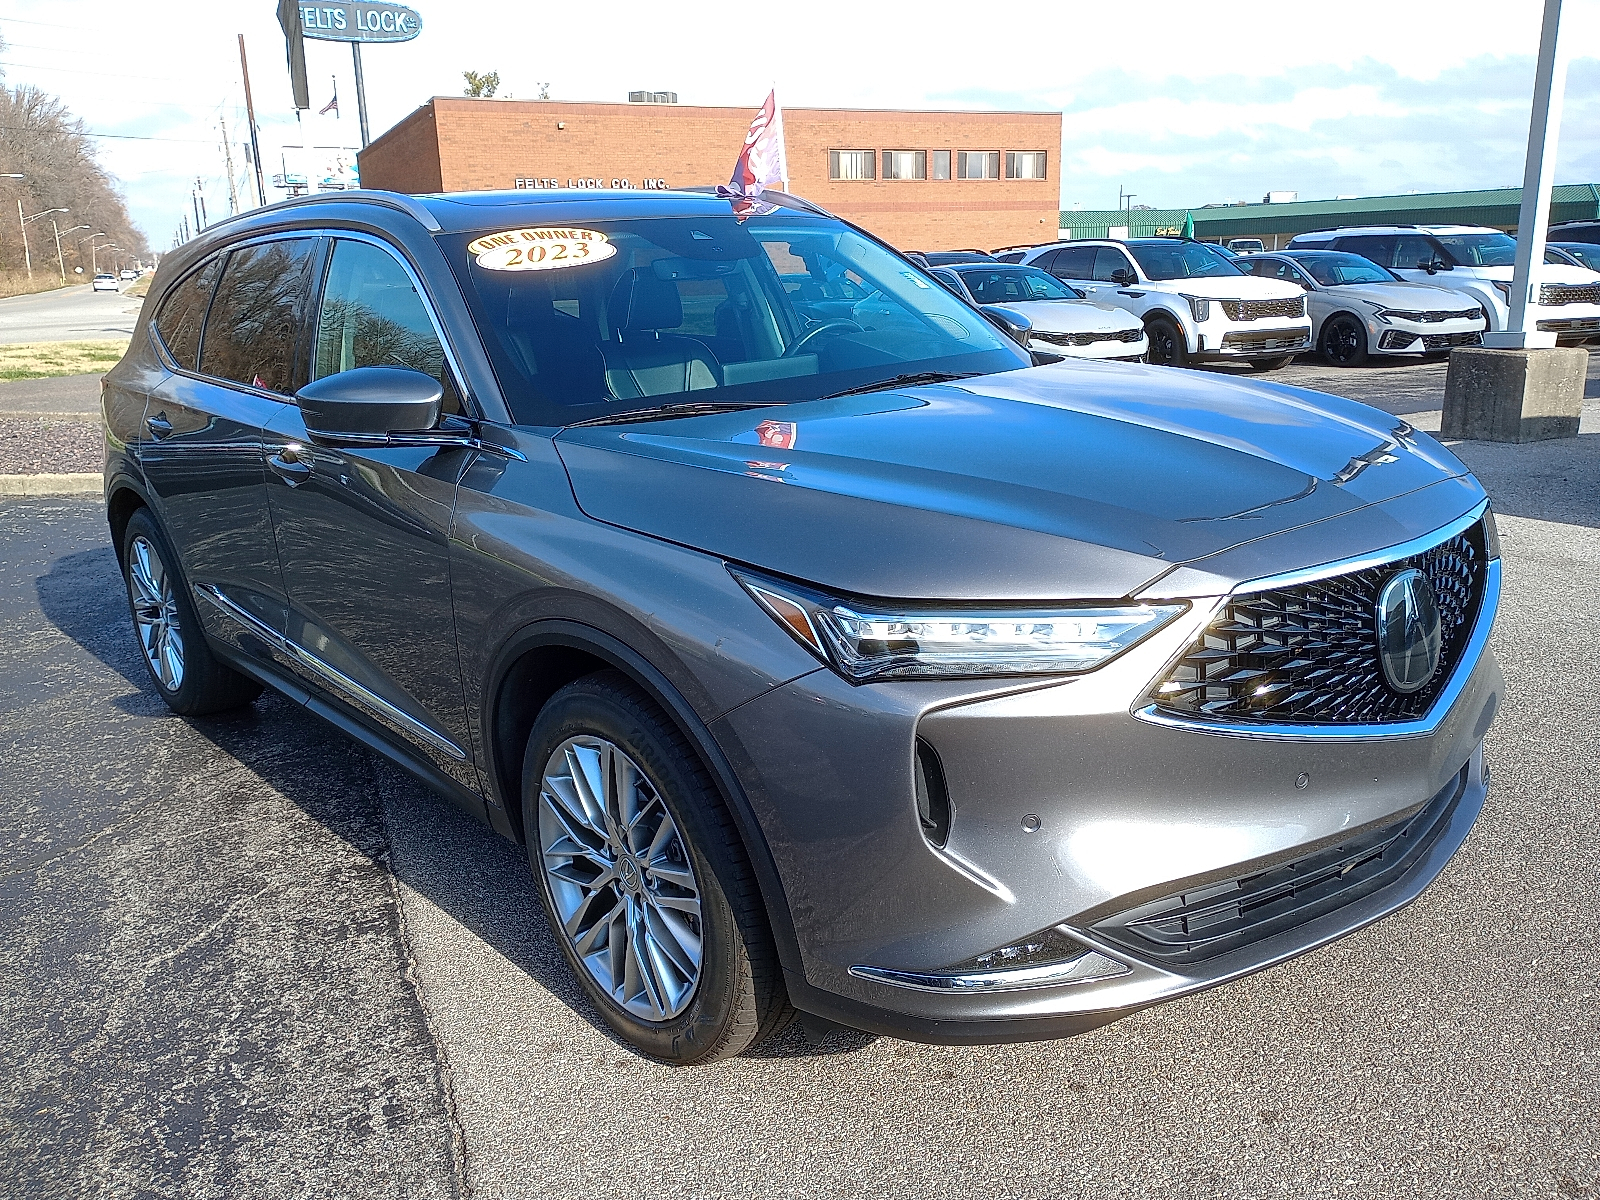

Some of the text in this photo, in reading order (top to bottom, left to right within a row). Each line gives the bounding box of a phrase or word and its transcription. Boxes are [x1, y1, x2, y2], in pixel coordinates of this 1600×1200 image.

[356, 9, 408, 33] LOCK
[515, 178, 559, 189] FELTS
[568, 178, 603, 189] LOCK
[643, 178, 670, 190] INC.
[478, 230, 593, 250] ONE OWNER
[505, 242, 590, 267] 2023
